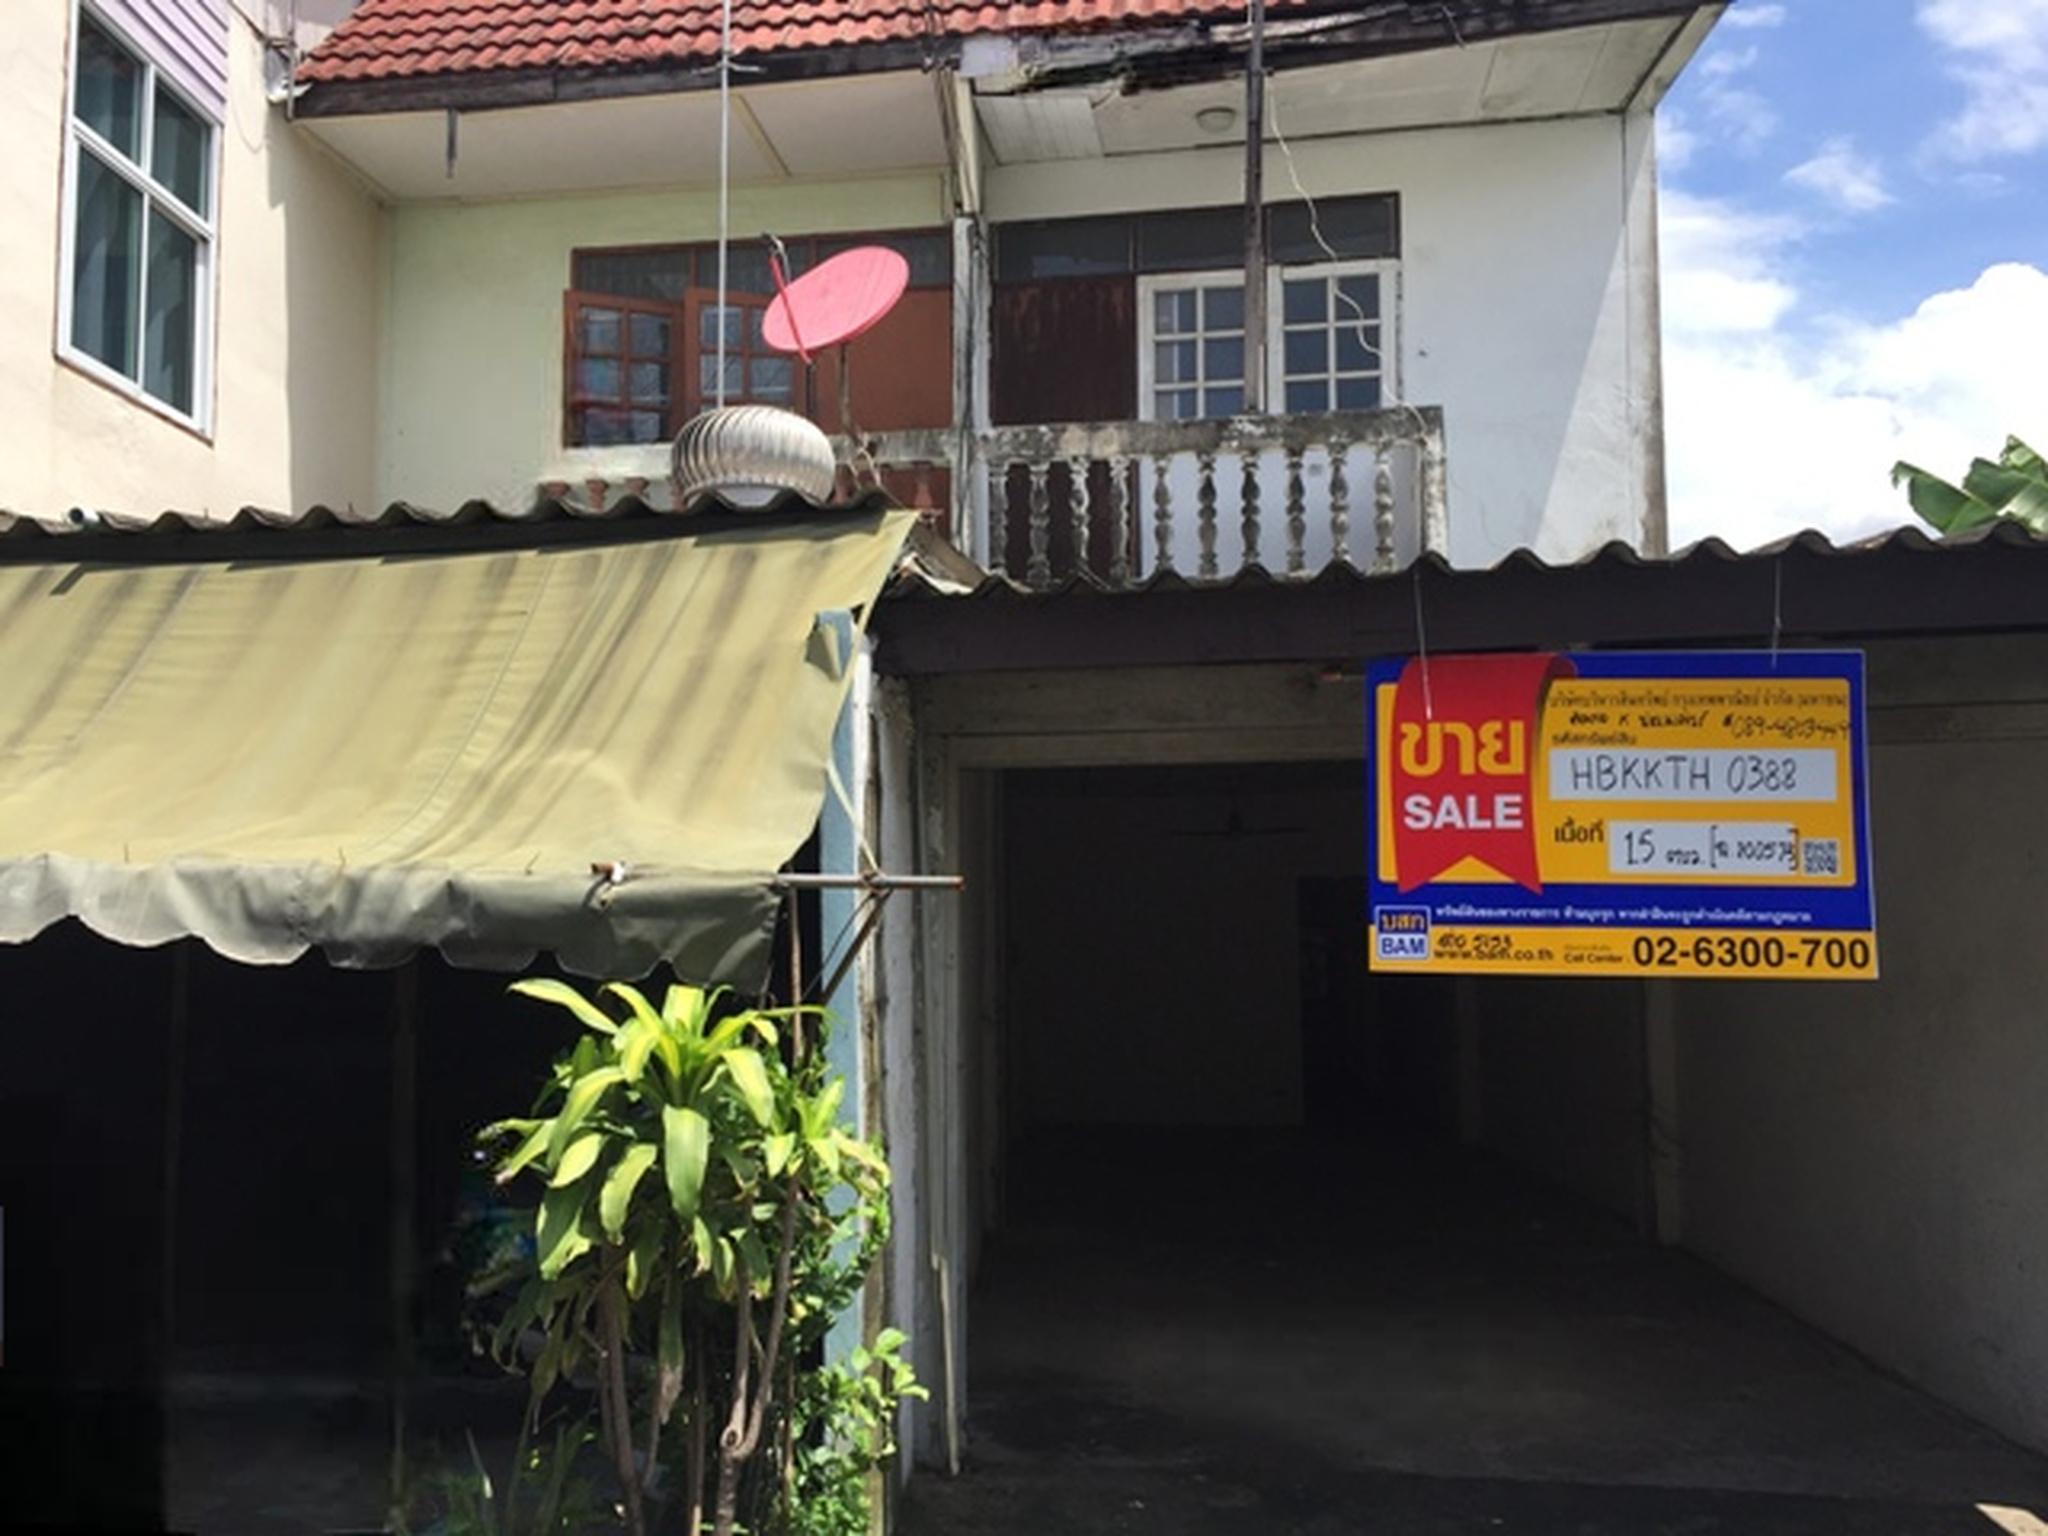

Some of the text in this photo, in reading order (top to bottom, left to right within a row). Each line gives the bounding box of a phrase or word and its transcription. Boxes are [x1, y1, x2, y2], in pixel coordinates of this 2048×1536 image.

[1399, 719, 1526, 778] ขาย
[1570, 755, 1798, 793] HBKKTH 0388
[1403, 793, 1524, 831] SALE
[1554, 816, 1605, 843] เนื้อที่
[1624, 828, 1656, 866] 15
[1381, 914, 1425, 931] บสก
[1381, 938, 1425, 955] BAM
[1632, 935, 1871, 969] 02-6300-700
